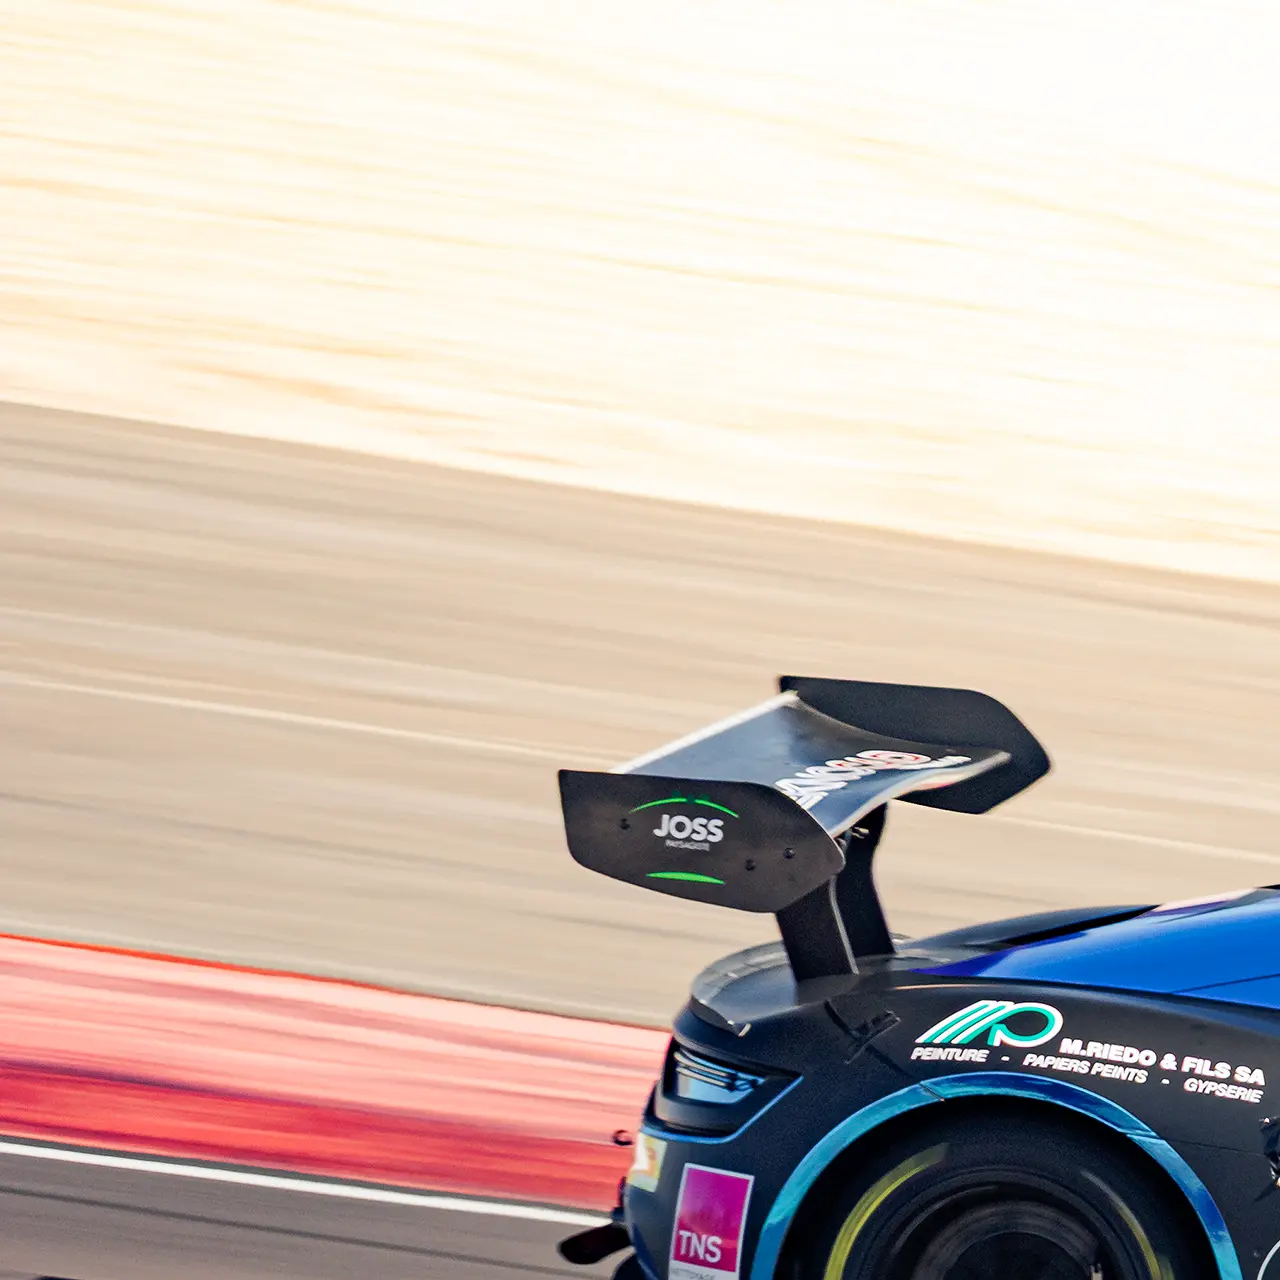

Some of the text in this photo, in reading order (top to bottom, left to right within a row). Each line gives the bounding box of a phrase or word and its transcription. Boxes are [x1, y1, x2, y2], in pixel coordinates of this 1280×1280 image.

[653, 814, 724, 843] JOSS
[910, 1046, 990, 1063] PEINTURE
[1023, 1053, 1090, 1076] PAPIERS
[1091, 1061, 1149, 1084] PEINTS
[1184, 1077, 1264, 1104] GYPSERIE
[1059, 1037, 1266, 1086] M.RIEDO & FILS SA
[679, 1230, 722, 1263] TNS
